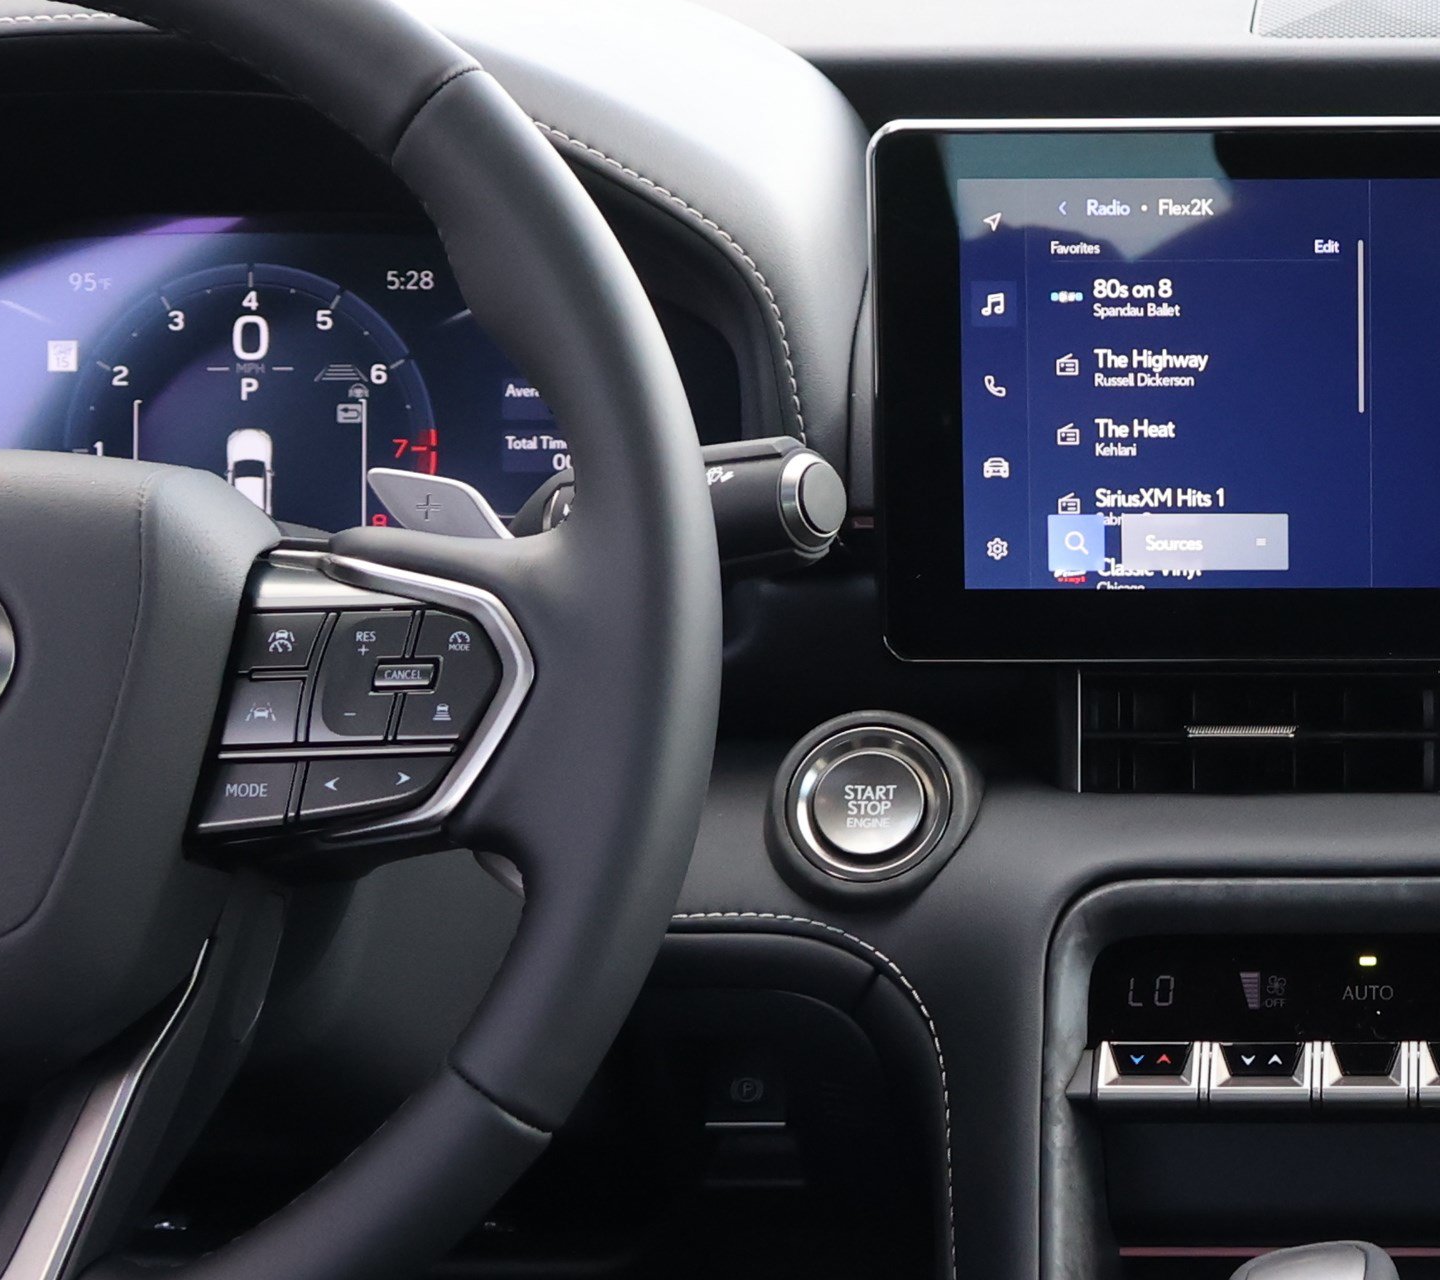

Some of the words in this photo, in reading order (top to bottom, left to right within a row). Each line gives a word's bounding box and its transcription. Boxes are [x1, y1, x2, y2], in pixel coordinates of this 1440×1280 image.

[1087, 199, 1130, 215] Radio
[1159, 199, 1214, 216] Flex2K
[1050, 241, 1100, 255] Favorites
[1314, 240, 1340, 253] Edit
[386, 270, 435, 291] 5:28
[1093, 279, 1129, 299] 80s
[1132, 284, 1155, 299] on
[1158, 279, 1173, 299] 8
[242, 291, 258, 311] 4
[1093, 304, 1144, 319] Spandau
[1148, 304, 1181, 318] Ballet
[167, 310, 185, 331] 3
[315, 310, 334, 331] 5
[232, 315, 269, 361] 0
[1093, 349, 1128, 369] The
[1132, 349, 1208, 372] Highway
[111, 365, 129, 387] 2
[370, 363, 388, 385] 6
[1094, 374, 1135, 387] Russell
[1137, 374, 1195, 387] Dickerson
[240, 378, 258, 401] P
[1095, 419, 1129, 439] The
[1133, 419, 1176, 439] Heat
[93, 441, 104, 457] 1
[392, 439, 409, 459] 7
[505, 435, 538, 450] Total
[1095, 443, 1137, 457] Kehlani
[1095, 488, 1173, 508] SiriusXM
[1177, 488, 1212, 508] Hits
[1216, 488, 1226, 507] 1
[1145, 534, 1203, 552] Sources
[355, 631, 376, 642] RES
[384, 670, 423, 680] CANCEL
[225, 783, 268, 797] MODE
[844, 785, 897, 800] START
[847, 801, 892, 815] STOP
[846, 817, 890, 828] ENGINE
[1128, 975, 1175, 1007] LO
[1342, 985, 1394, 1001] AUTO
[1264, 998, 1287, 1008] OFF
